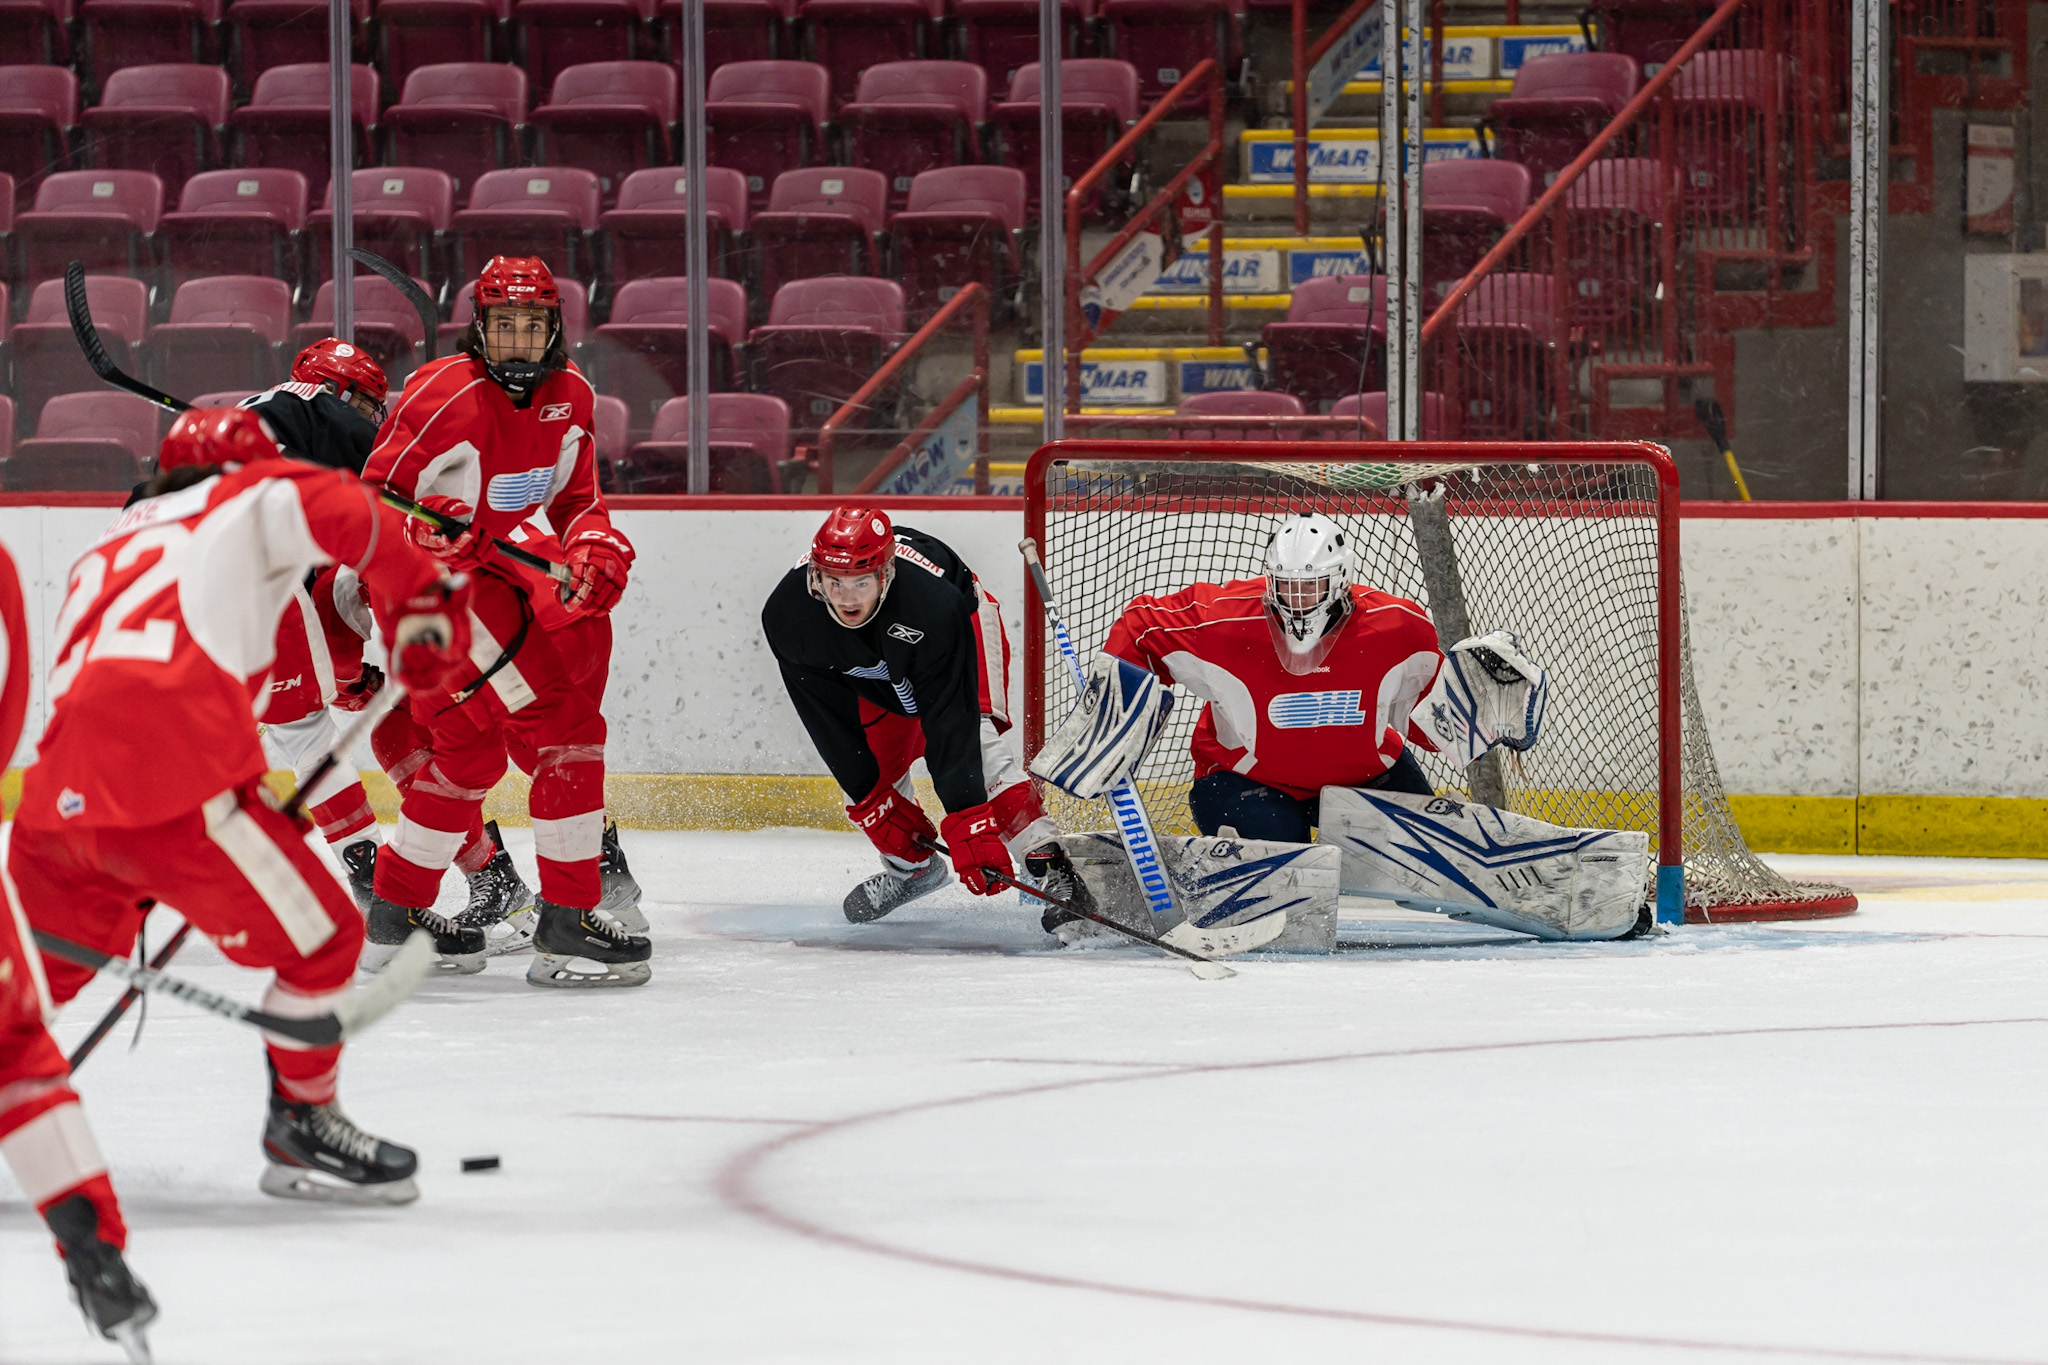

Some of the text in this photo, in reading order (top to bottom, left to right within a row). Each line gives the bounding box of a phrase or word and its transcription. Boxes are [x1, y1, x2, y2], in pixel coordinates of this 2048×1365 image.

[507, 285, 537, 293] CCM
[824, 555, 851, 564] CCM
[269, 672, 302, 693] CM
[969, 817, 998, 835] CC
[1110, 777, 1174, 913] WARRIOR
